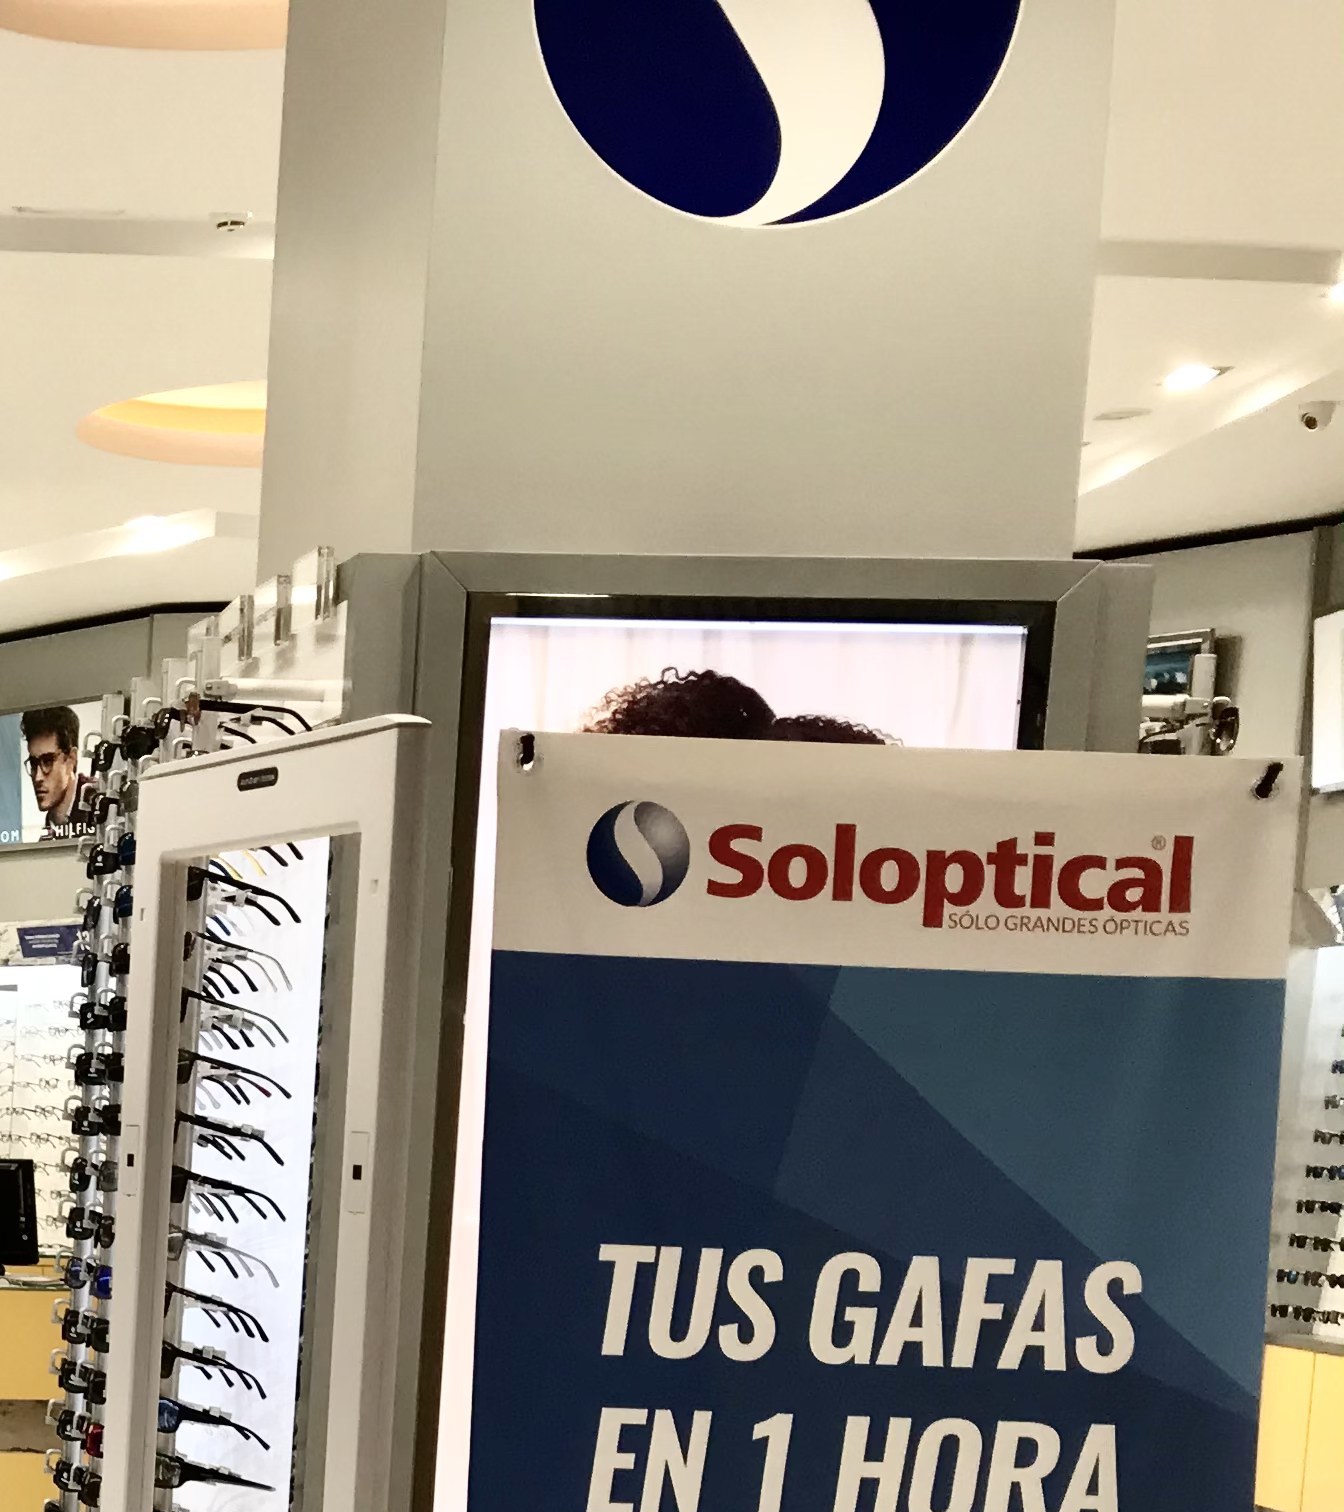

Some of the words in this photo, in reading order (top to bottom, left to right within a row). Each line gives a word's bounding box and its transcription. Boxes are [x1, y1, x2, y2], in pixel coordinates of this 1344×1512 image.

[706, 822, 1195, 928] Soloptical
[948, 908, 1000, 932] SÓLO
[1004, 914, 1099, 935] GRANDES
[1103, 913, 1191, 937] ÓPTICAS
[598, 1243, 784, 1362] TUS
[809, 1251, 1143, 1374] GAFAS
